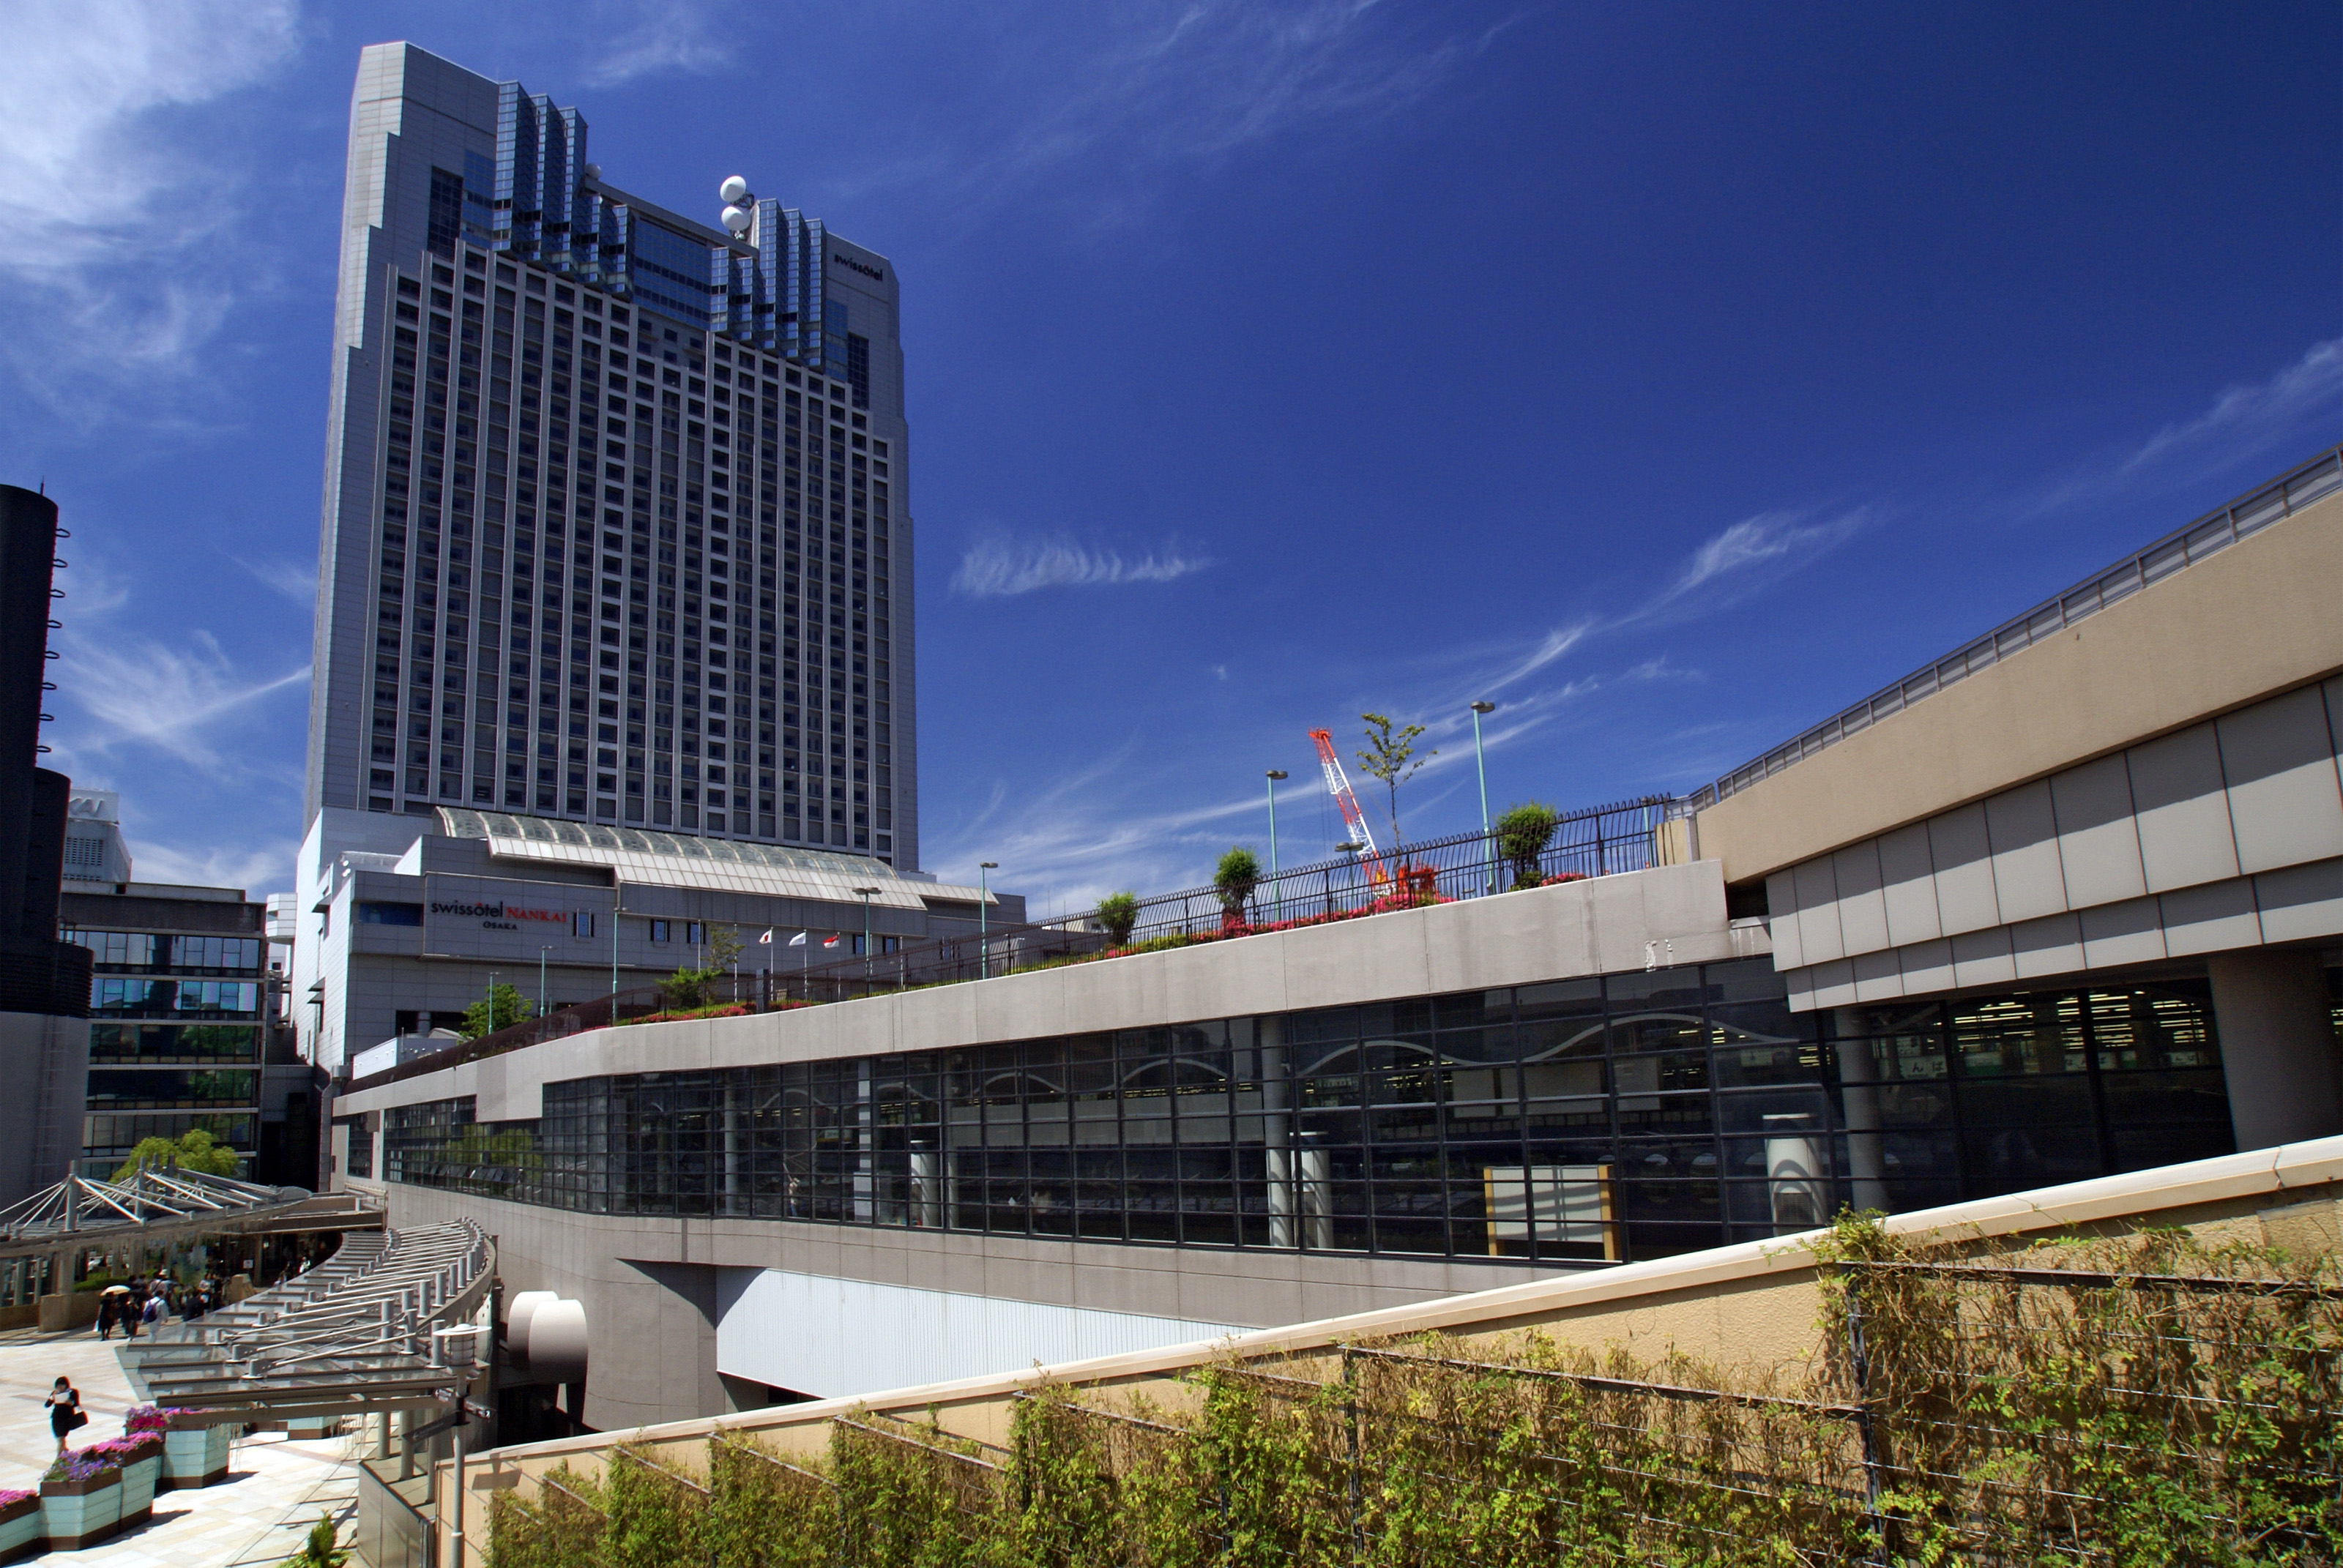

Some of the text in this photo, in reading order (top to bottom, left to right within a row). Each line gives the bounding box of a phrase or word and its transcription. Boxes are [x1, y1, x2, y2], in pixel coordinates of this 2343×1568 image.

[431, 900, 567, 922] swissôtel NANKAI
[483, 920, 518, 930] OSAKA
